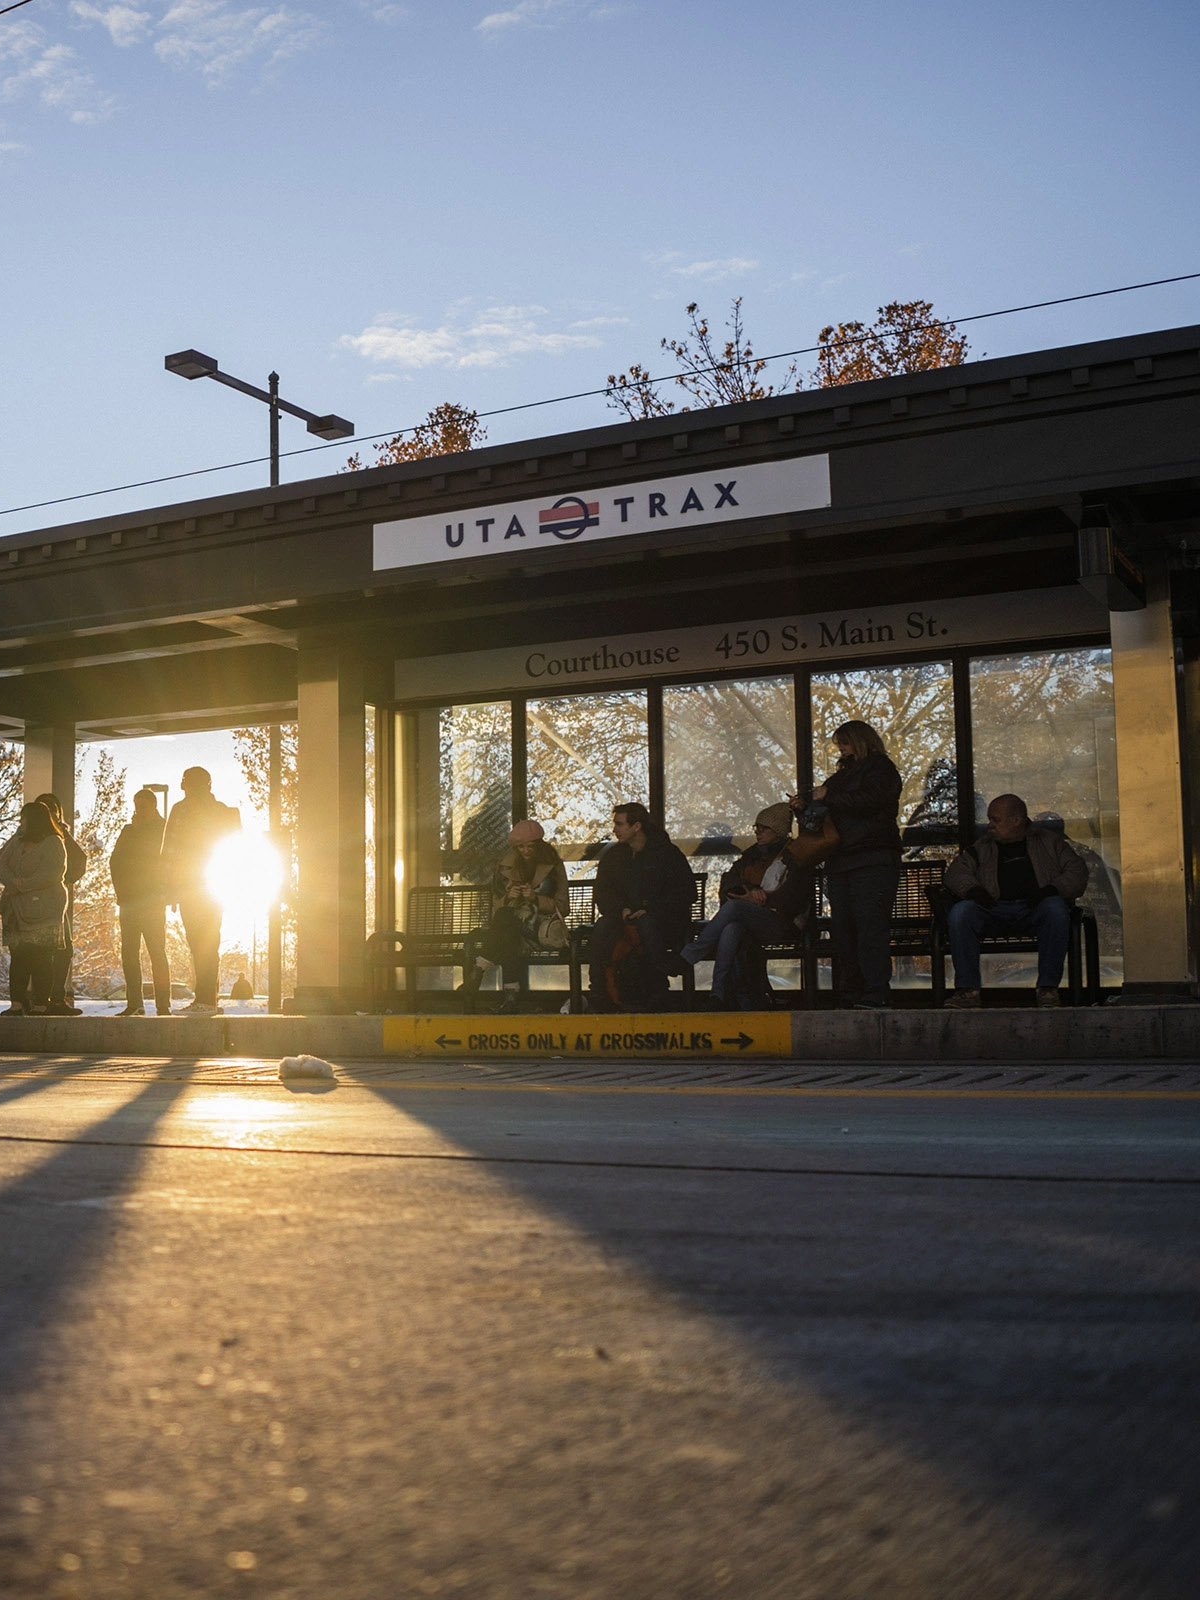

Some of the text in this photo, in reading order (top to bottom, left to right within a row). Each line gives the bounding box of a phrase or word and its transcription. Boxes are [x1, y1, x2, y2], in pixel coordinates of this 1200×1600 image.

[445, 481, 739, 547] UTA TRAX
[524, 611, 948, 678] Courthouse 450 S. Main St.
[468, 1032, 713, 1051] CROSS ONLY AT CROSSWALKS
